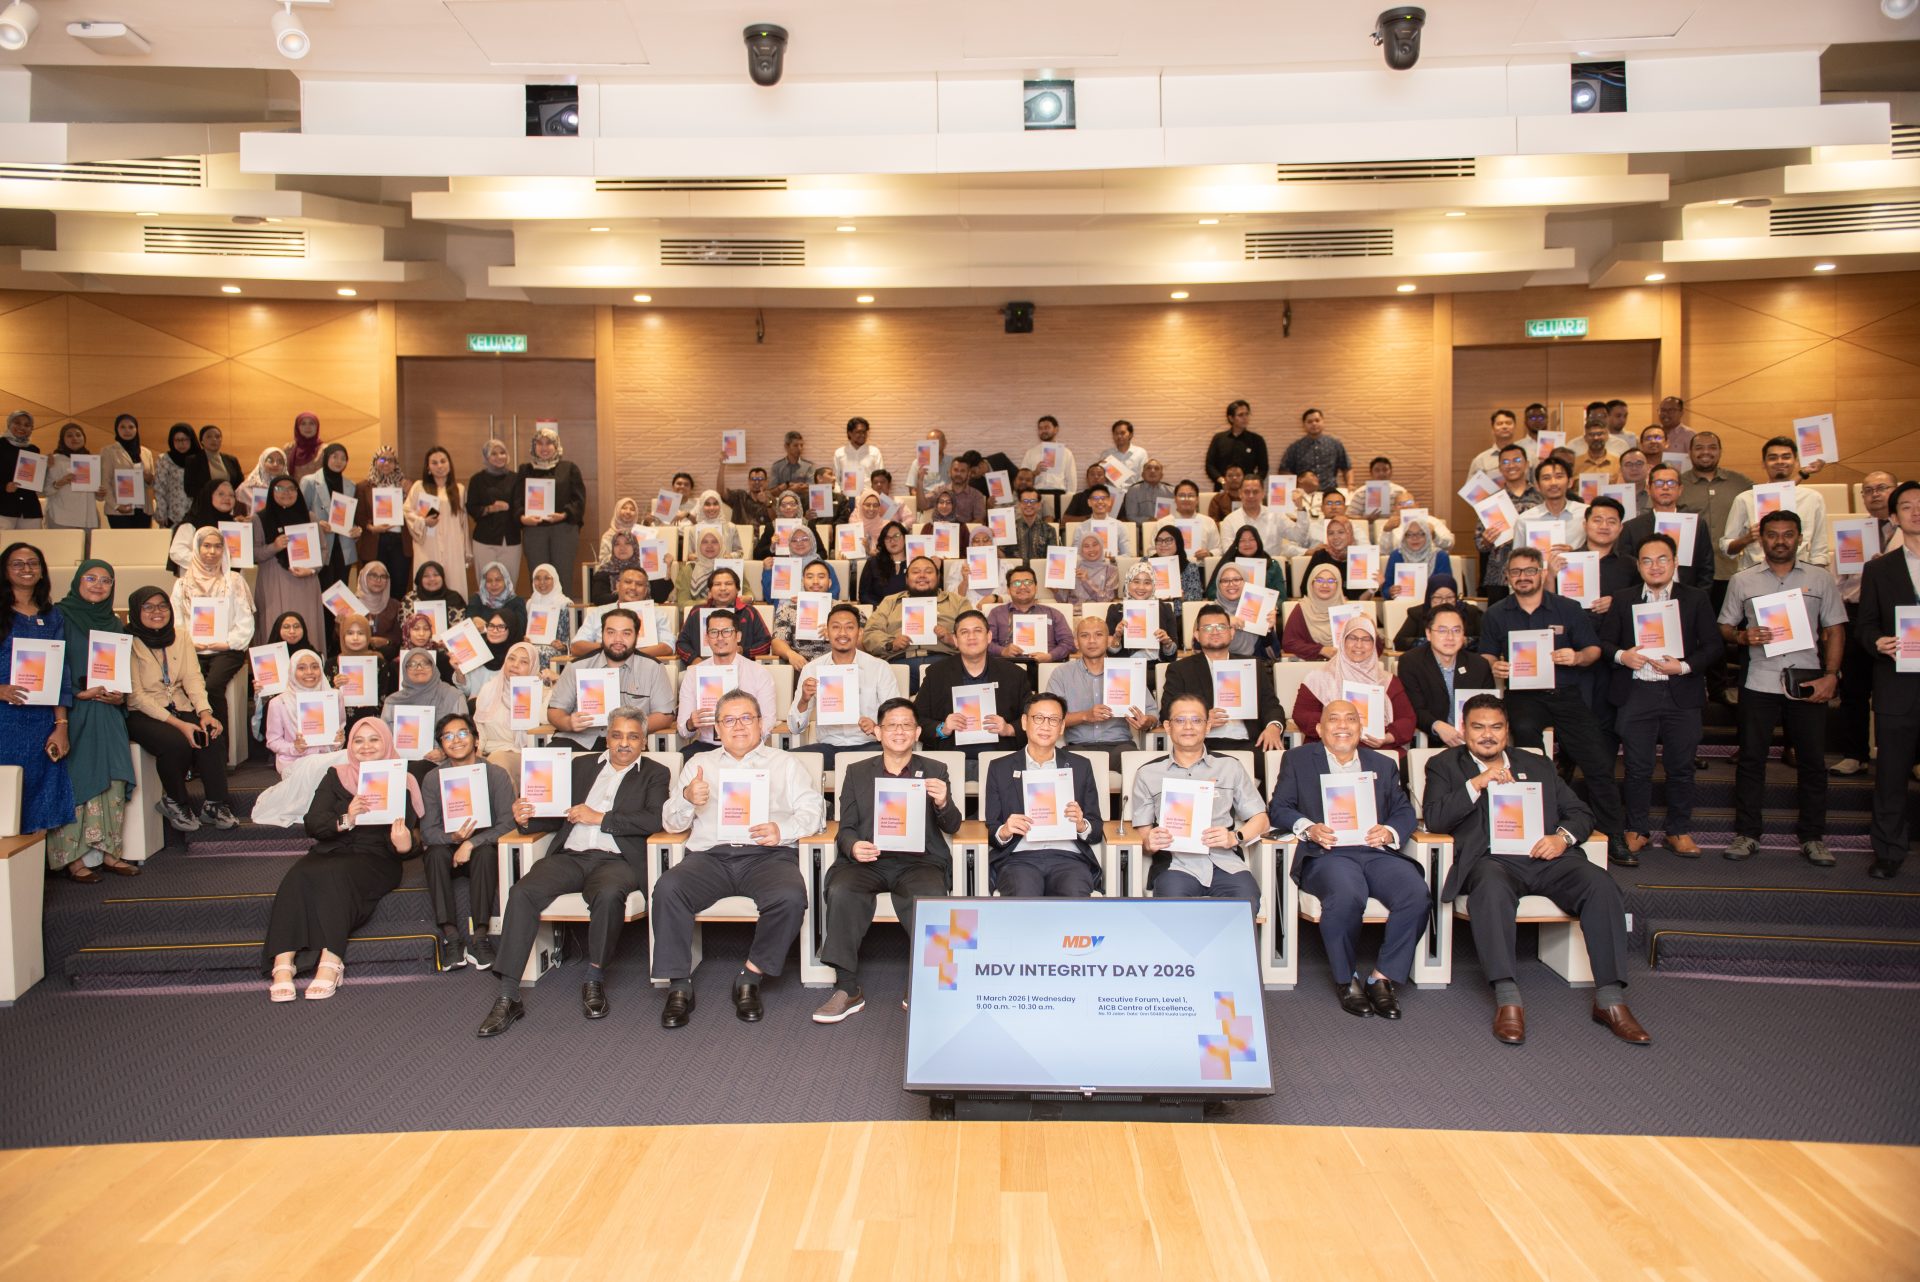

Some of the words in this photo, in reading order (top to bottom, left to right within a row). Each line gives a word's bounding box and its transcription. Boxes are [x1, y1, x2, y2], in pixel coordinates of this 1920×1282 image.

[1528, 319, 1575, 337] KELUAR
[469, 335, 514, 352] KELUAR
[975, 963, 1015, 976] MDV
[1020, 964, 1108, 977] INTEGRITY
[1113, 964, 1149, 977] DAY
[1153, 964, 1195, 977] 2026
[1031, 995, 1076, 1003] Wednesday
[1134, 996, 1161, 1004] Forum,
[1153, 1005, 1195, 1013] Excellence,
